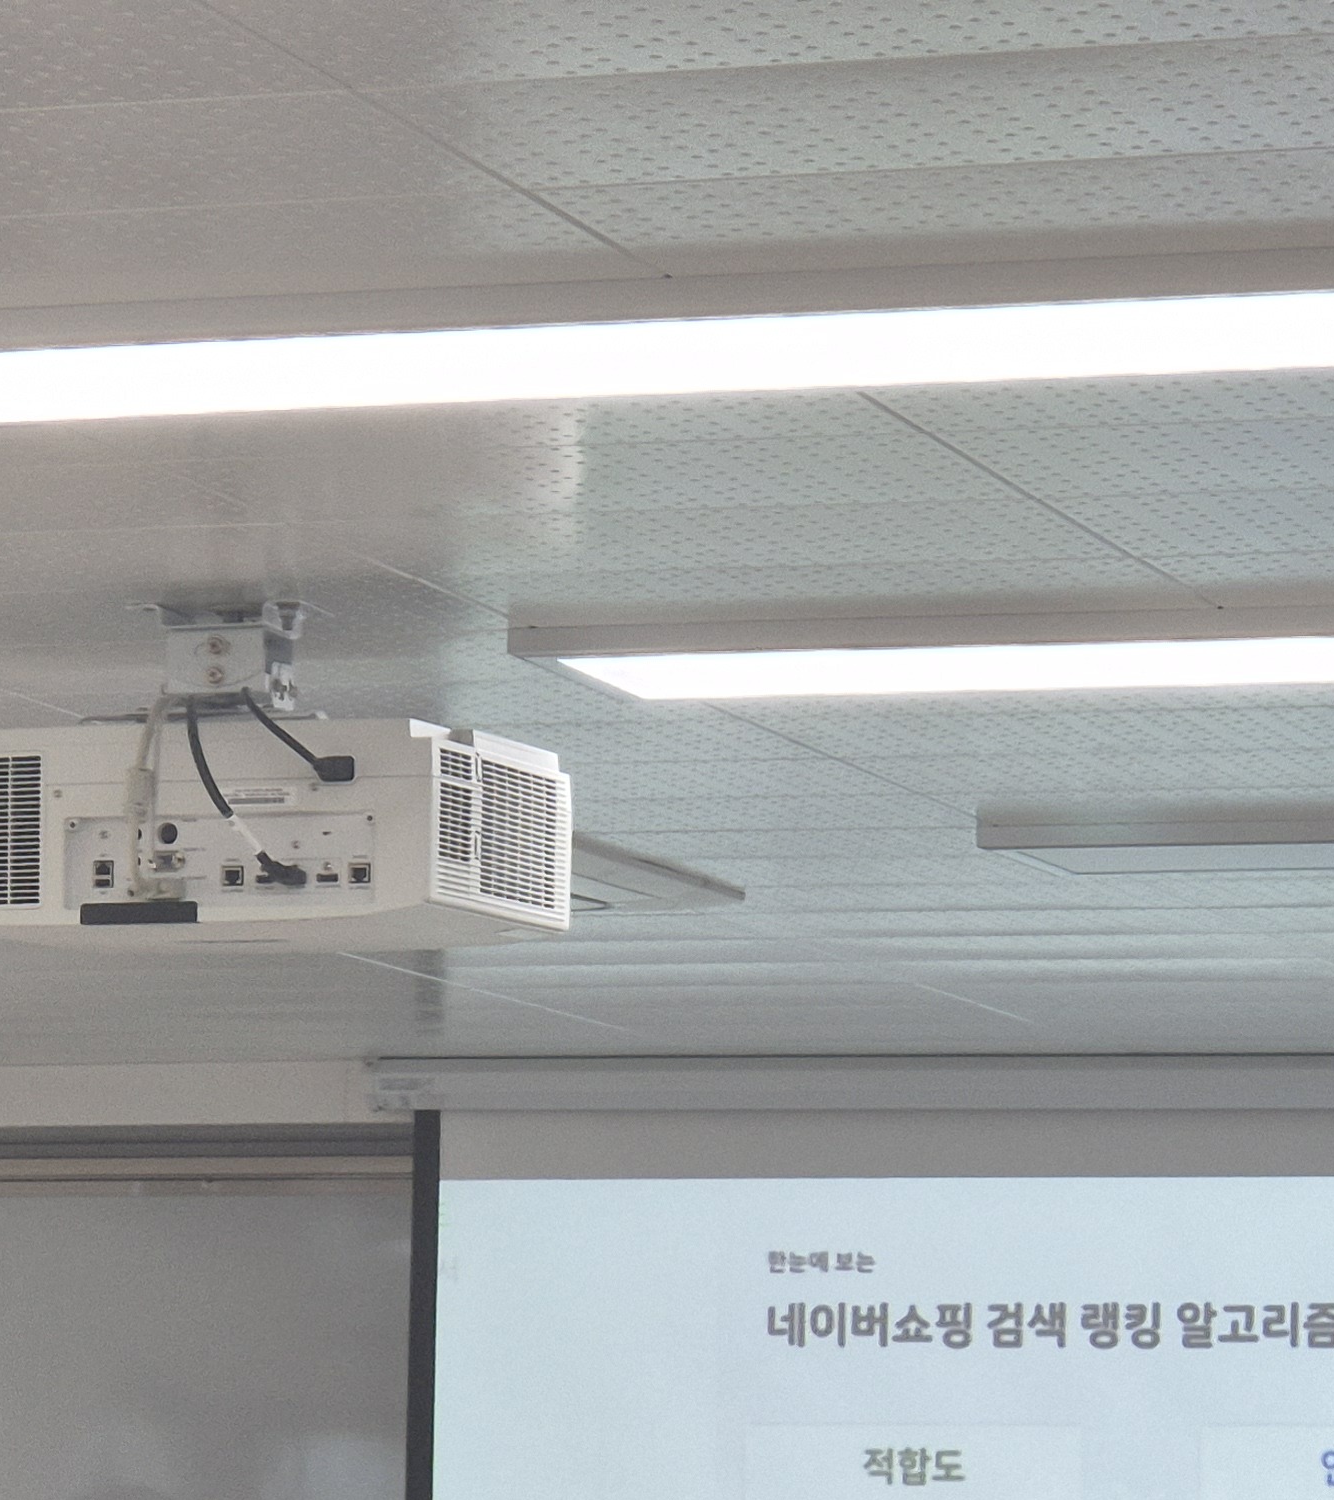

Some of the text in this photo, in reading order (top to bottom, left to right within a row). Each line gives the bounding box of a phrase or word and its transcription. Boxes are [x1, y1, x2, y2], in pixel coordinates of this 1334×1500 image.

[768, 1250, 876, 1274] 한눈에 보는
[767, 1302, 973, 1348] 네이버쇼핑
[987, 1302, 1067, 1349] 검색
[1080, 1303, 1162, 1349] 랭킹
[863, 1447, 966, 1486] 적합도
